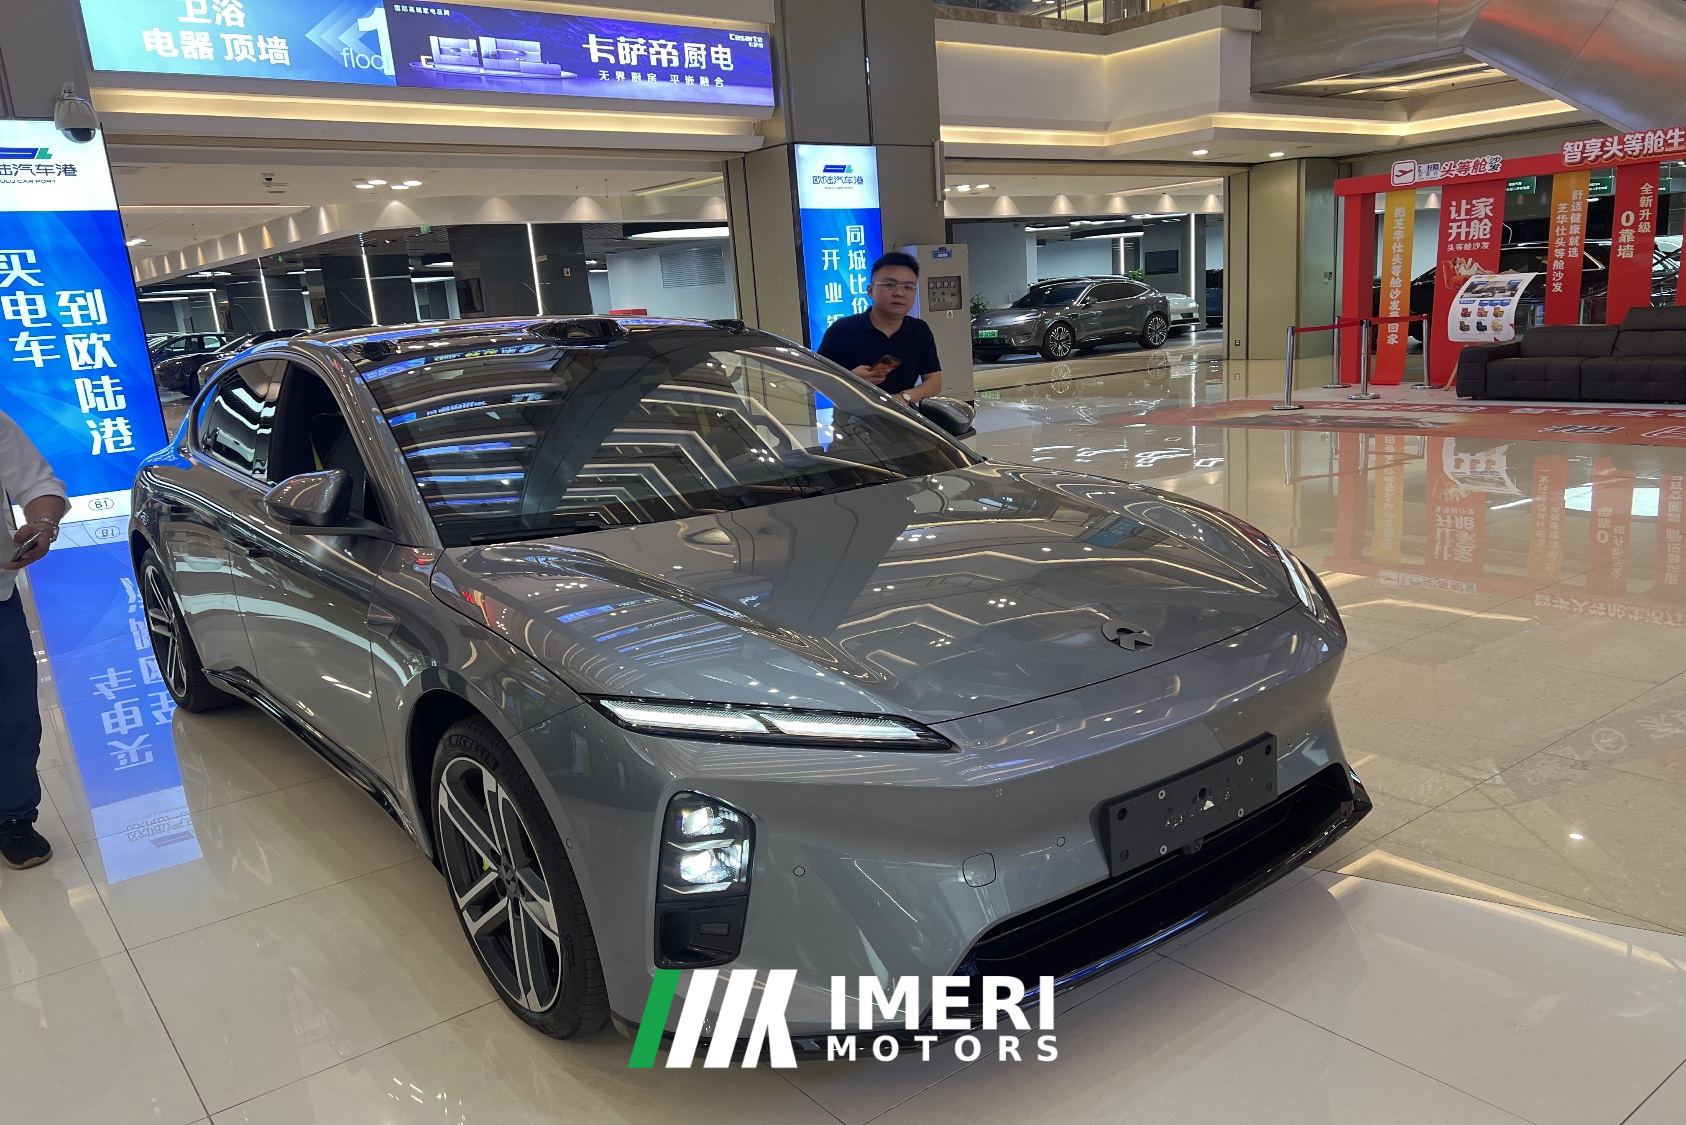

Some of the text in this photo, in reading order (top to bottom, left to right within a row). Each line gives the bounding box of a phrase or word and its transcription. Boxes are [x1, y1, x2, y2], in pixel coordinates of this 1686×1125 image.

[177, 0, 246, 28] 卫浴
[142, 27, 291, 66] 电器 顶墙
[357, 7, 395, 76] 1
[582, 33, 734, 71] 卡萨帝厨电
[598, 69, 725, 88] 无界厨房 平嵌融合
[1562, 127, 1686, 164] 智享头等舱生
[812, 175, 864, 185] 欧陆汽车港
[1440, 158, 1488, 177] 头等舱
[1450, 197, 1494, 220] 让家
[1568, 189, 1584, 258] 舒适健康就选
[1638, 182, 1654, 233] 全新升级
[1447, 218, 1492, 242] 升舱
[1551, 202, 1569, 293] 芝华仕头等舱沙发
[1617, 210, 1636, 259] 0靠墙
[845, 224, 869, 315] 同城比价
[0, 249, 61, 368] 买电车
[56, 288, 136, 456] 到欧陆港
